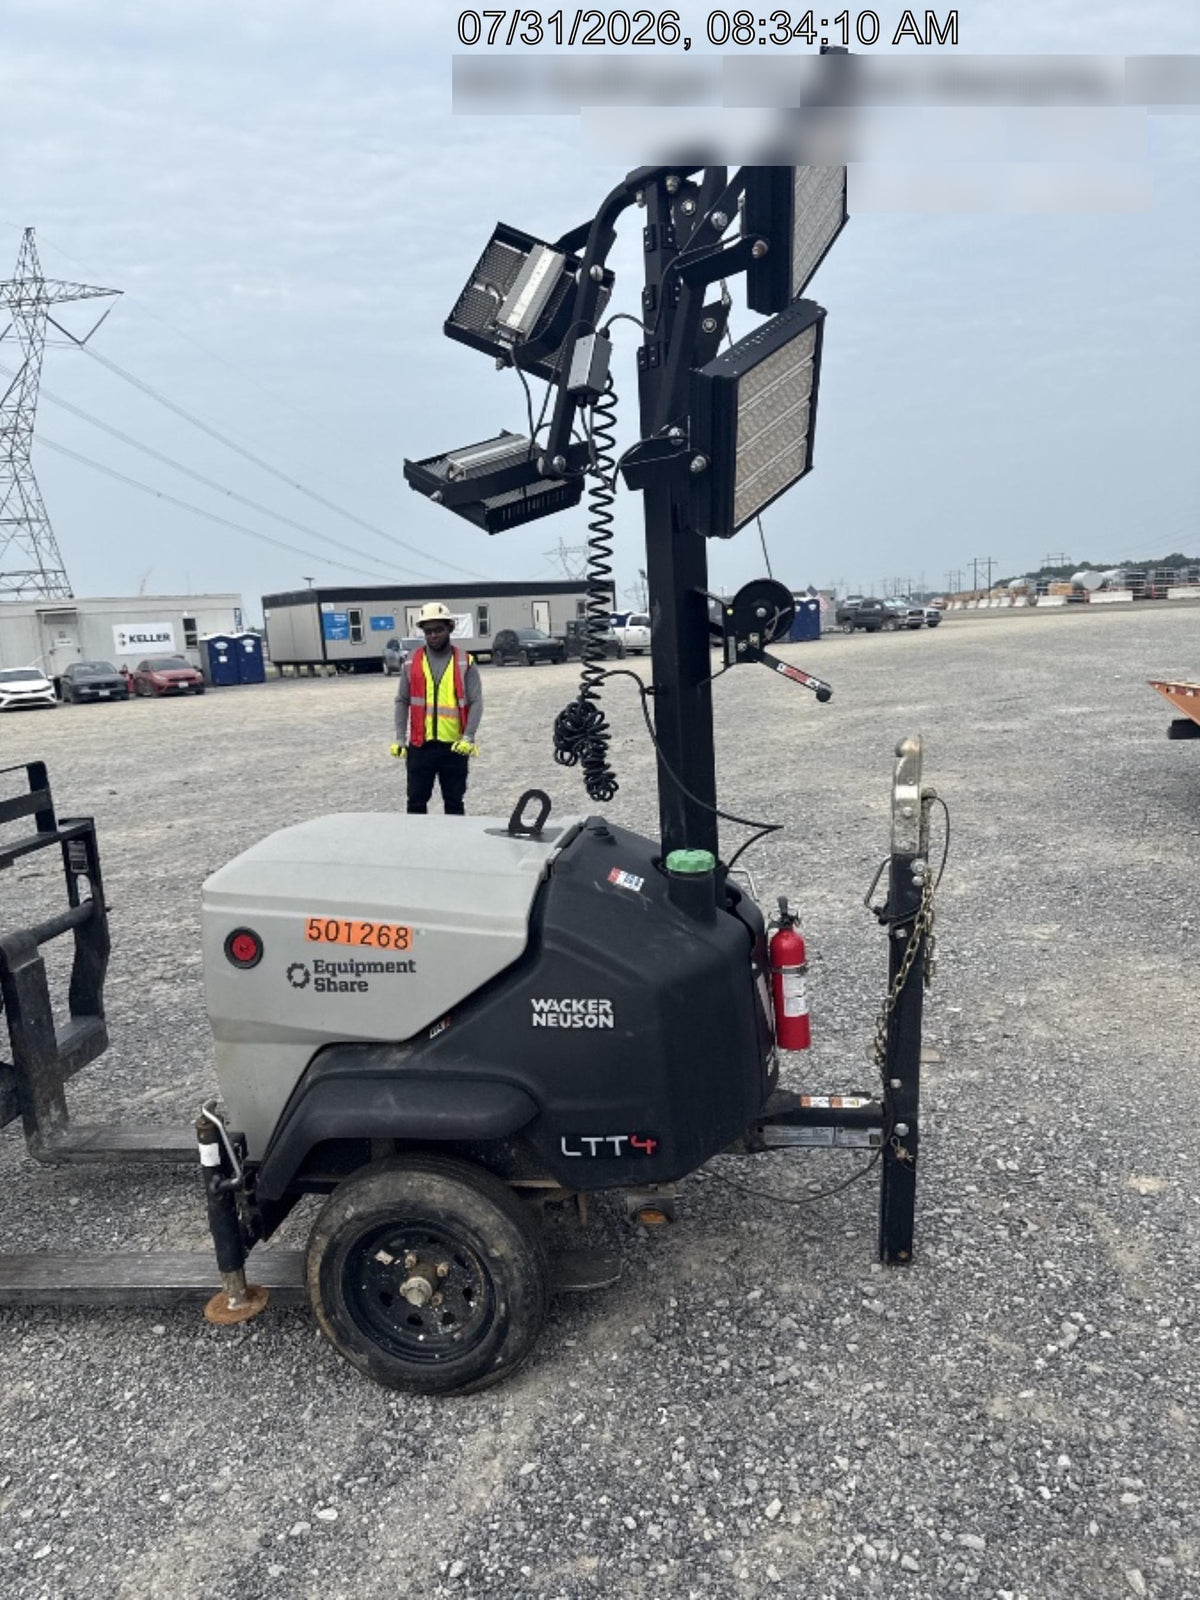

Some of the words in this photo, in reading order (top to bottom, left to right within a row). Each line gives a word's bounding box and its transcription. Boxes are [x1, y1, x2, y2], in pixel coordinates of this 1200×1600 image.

[129, 632, 171, 643] KELLER
[308, 918, 408, 950] 501268
[312, 958, 417, 977] Equipment
[314, 977, 368, 993] Share
[530, 998, 614, 1014] WACKER
[532, 1013, 614, 1028] NEUSON
[561, 1135, 657, 1157] LTT4
